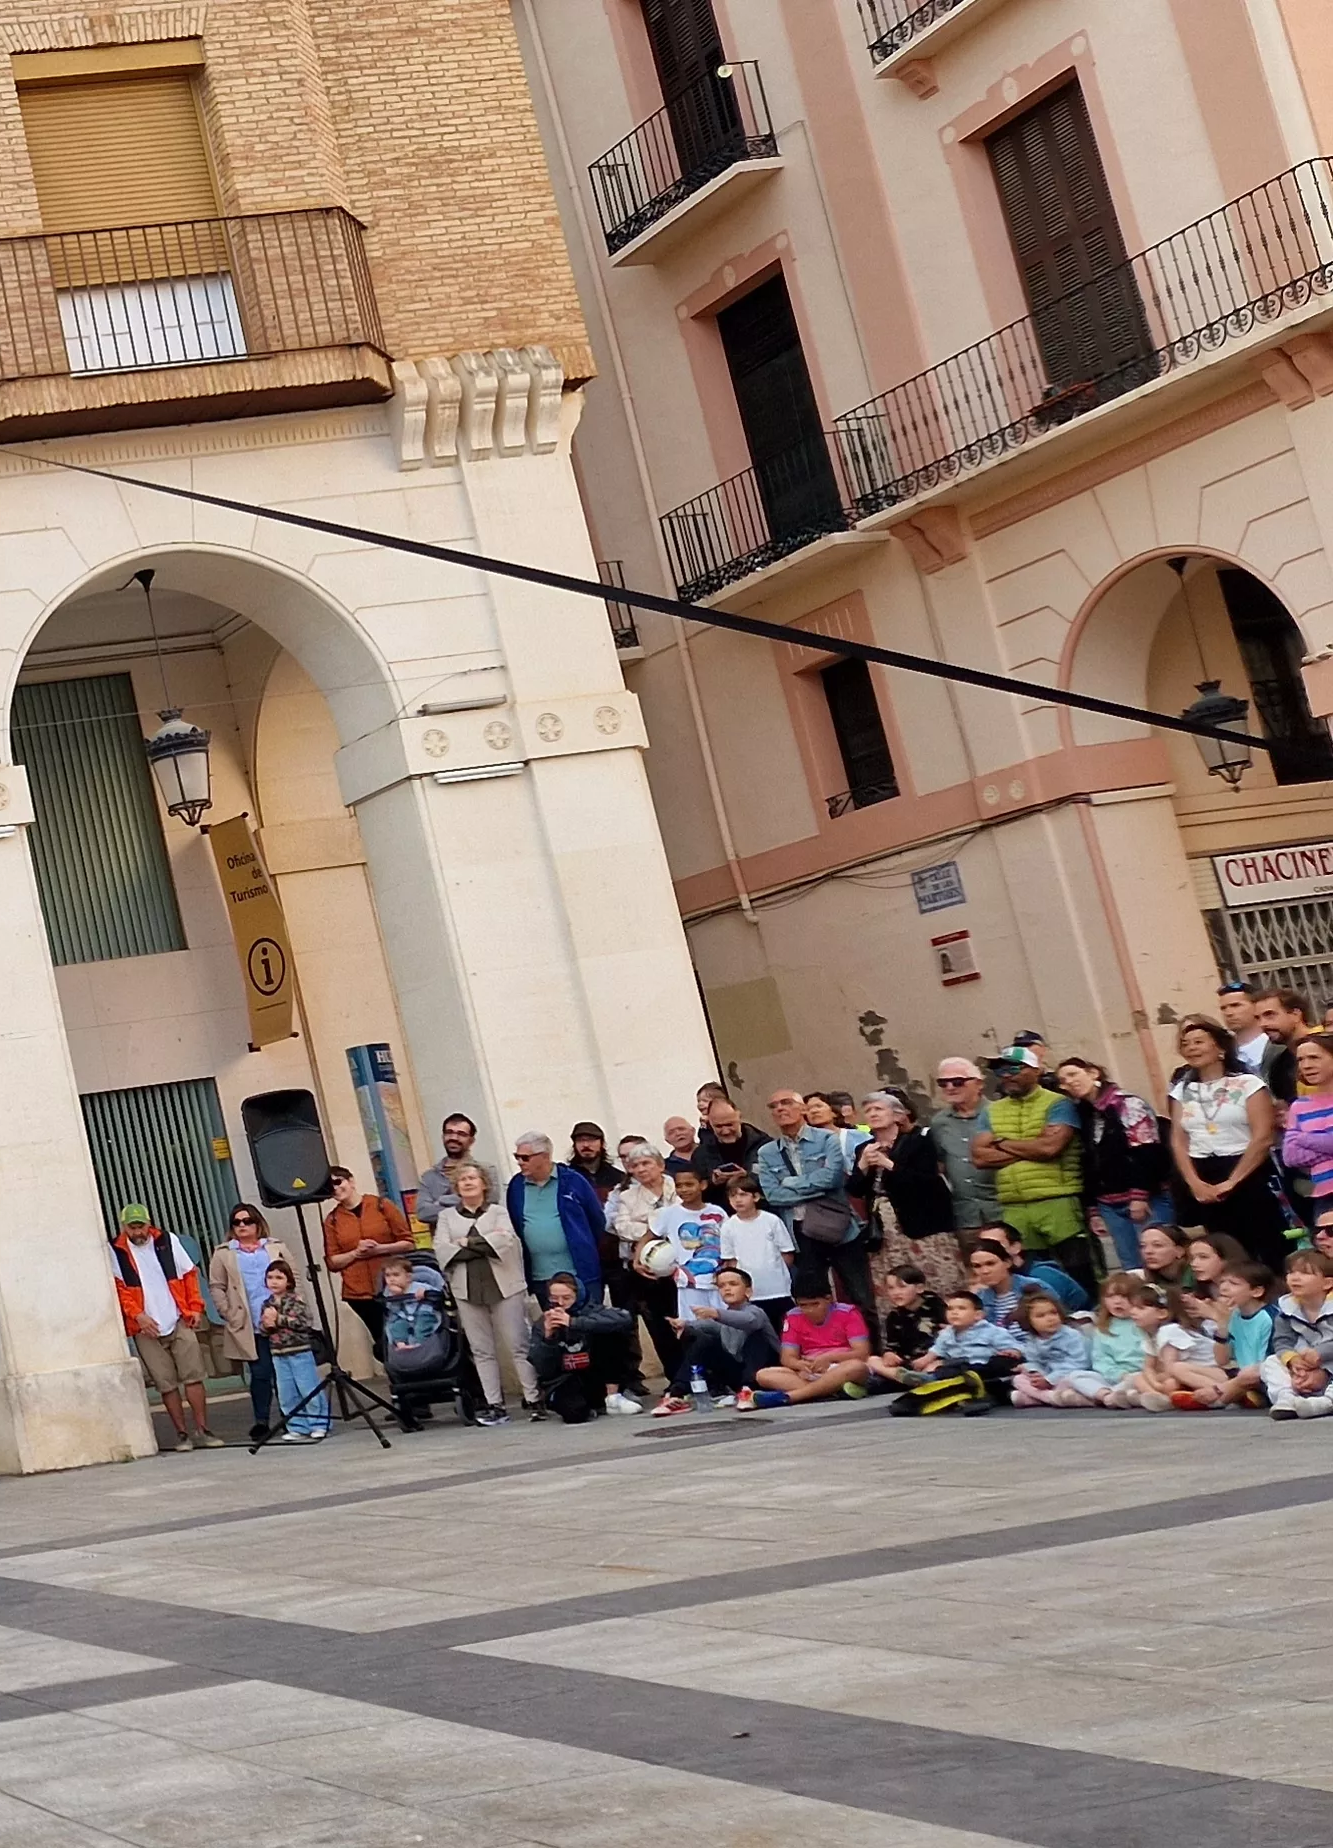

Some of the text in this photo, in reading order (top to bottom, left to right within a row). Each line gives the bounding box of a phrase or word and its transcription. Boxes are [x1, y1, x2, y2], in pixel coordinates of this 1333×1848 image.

[227, 852, 256, 869] Oficina
[252, 868, 263, 880] de
[230, 884, 269, 904] Turismo
